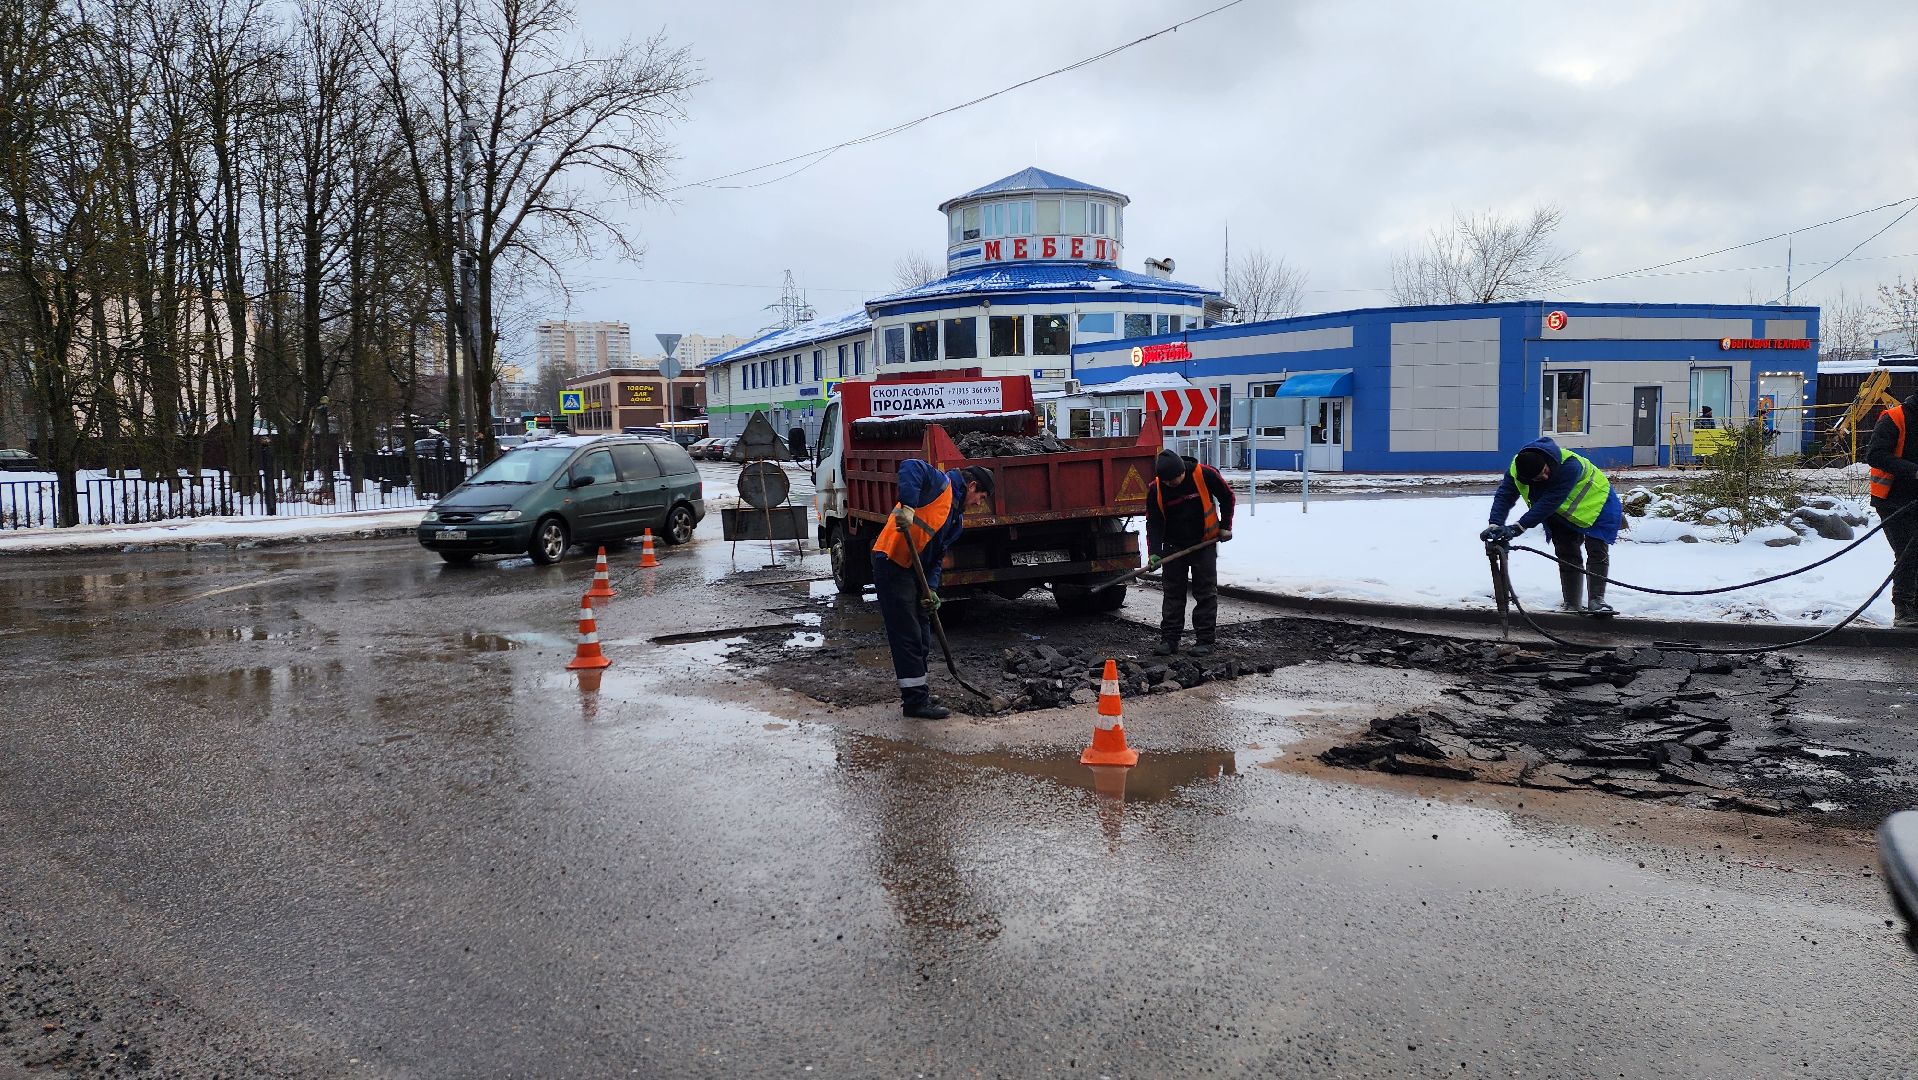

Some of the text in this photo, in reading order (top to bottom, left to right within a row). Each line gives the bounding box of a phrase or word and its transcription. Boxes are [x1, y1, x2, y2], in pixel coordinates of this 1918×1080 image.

[984, 236, 1117, 261] МЕБЕЛЬ
[1731, 339, 1812, 349] БЫТОВАЯ ТЕХНИКА
[873, 389, 899, 397] СКОЛ
[901, 387, 944, 397] АСФАЛЬТ
[873, 398, 945, 411] ПРОДАЖА
